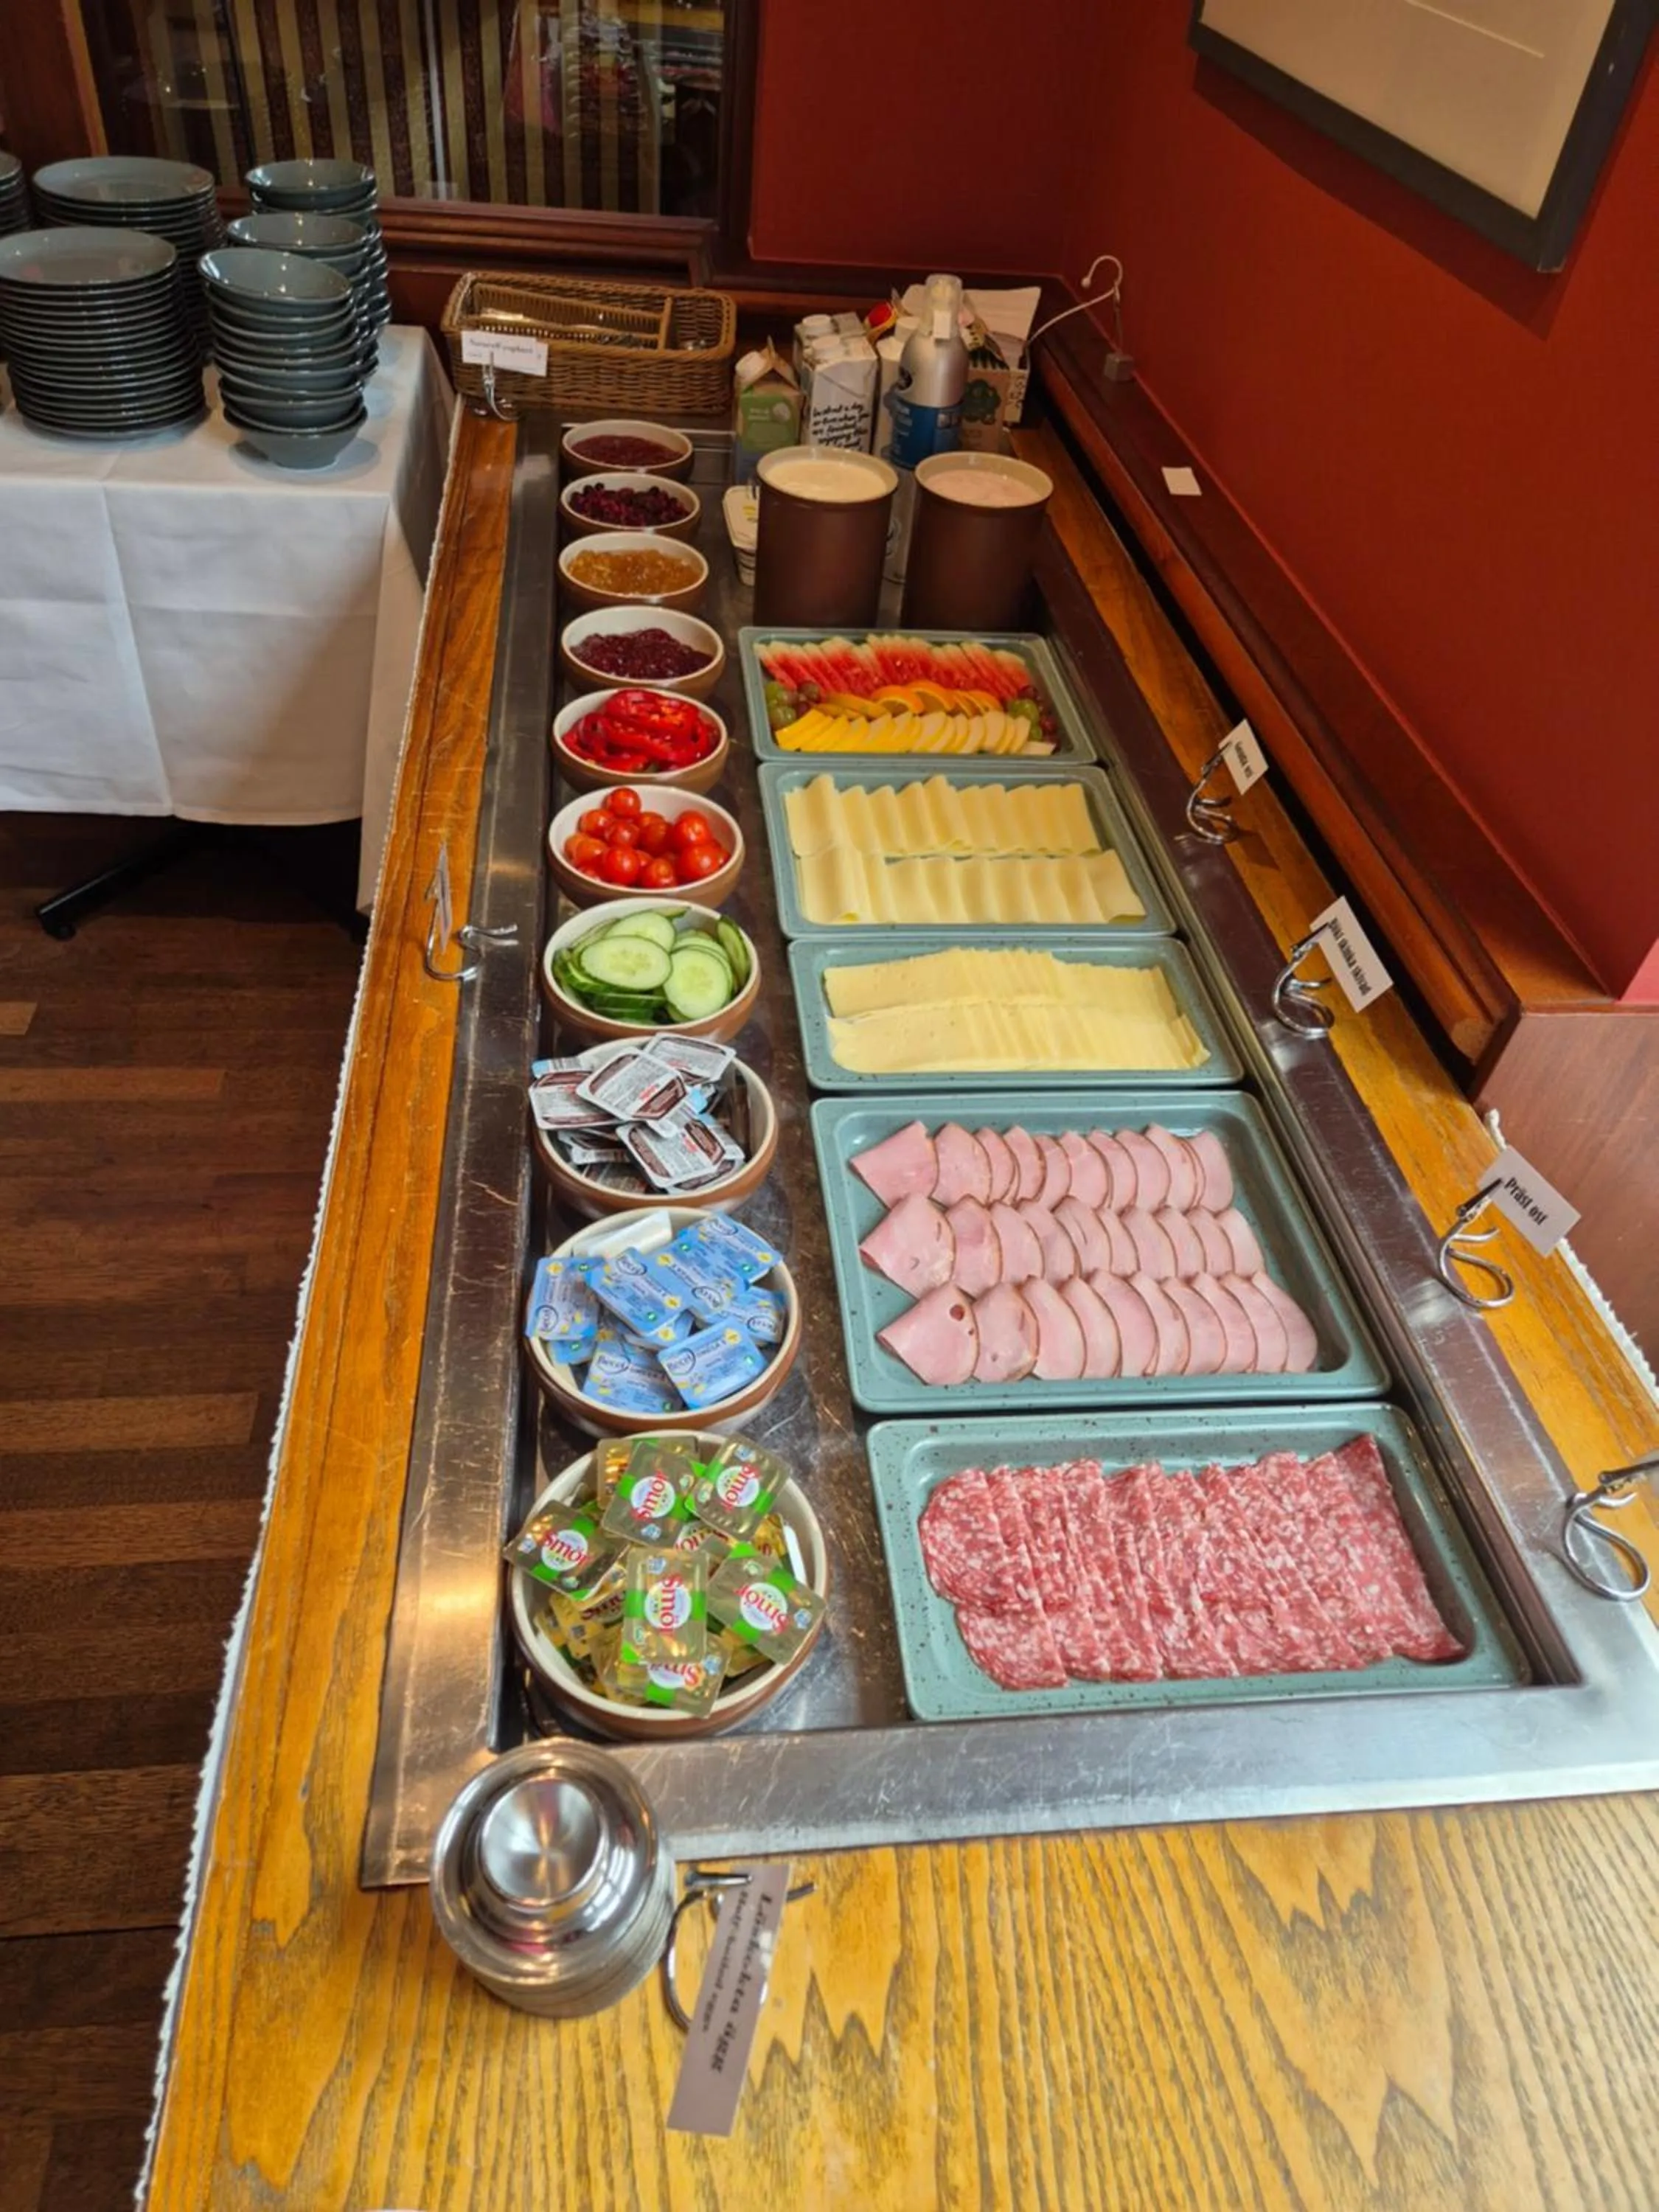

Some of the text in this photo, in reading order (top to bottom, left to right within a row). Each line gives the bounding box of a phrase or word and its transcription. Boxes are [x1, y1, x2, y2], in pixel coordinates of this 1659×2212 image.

[1503, 1177, 1548, 1226] Präst ost
[630, 1469, 667, 1523] Smör
[722, 1463, 760, 1512] Smör
[542, 1528, 594, 1568] Smör
[661, 1572, 683, 1636] Smör
[734, 1585, 790, 1632] Smör
